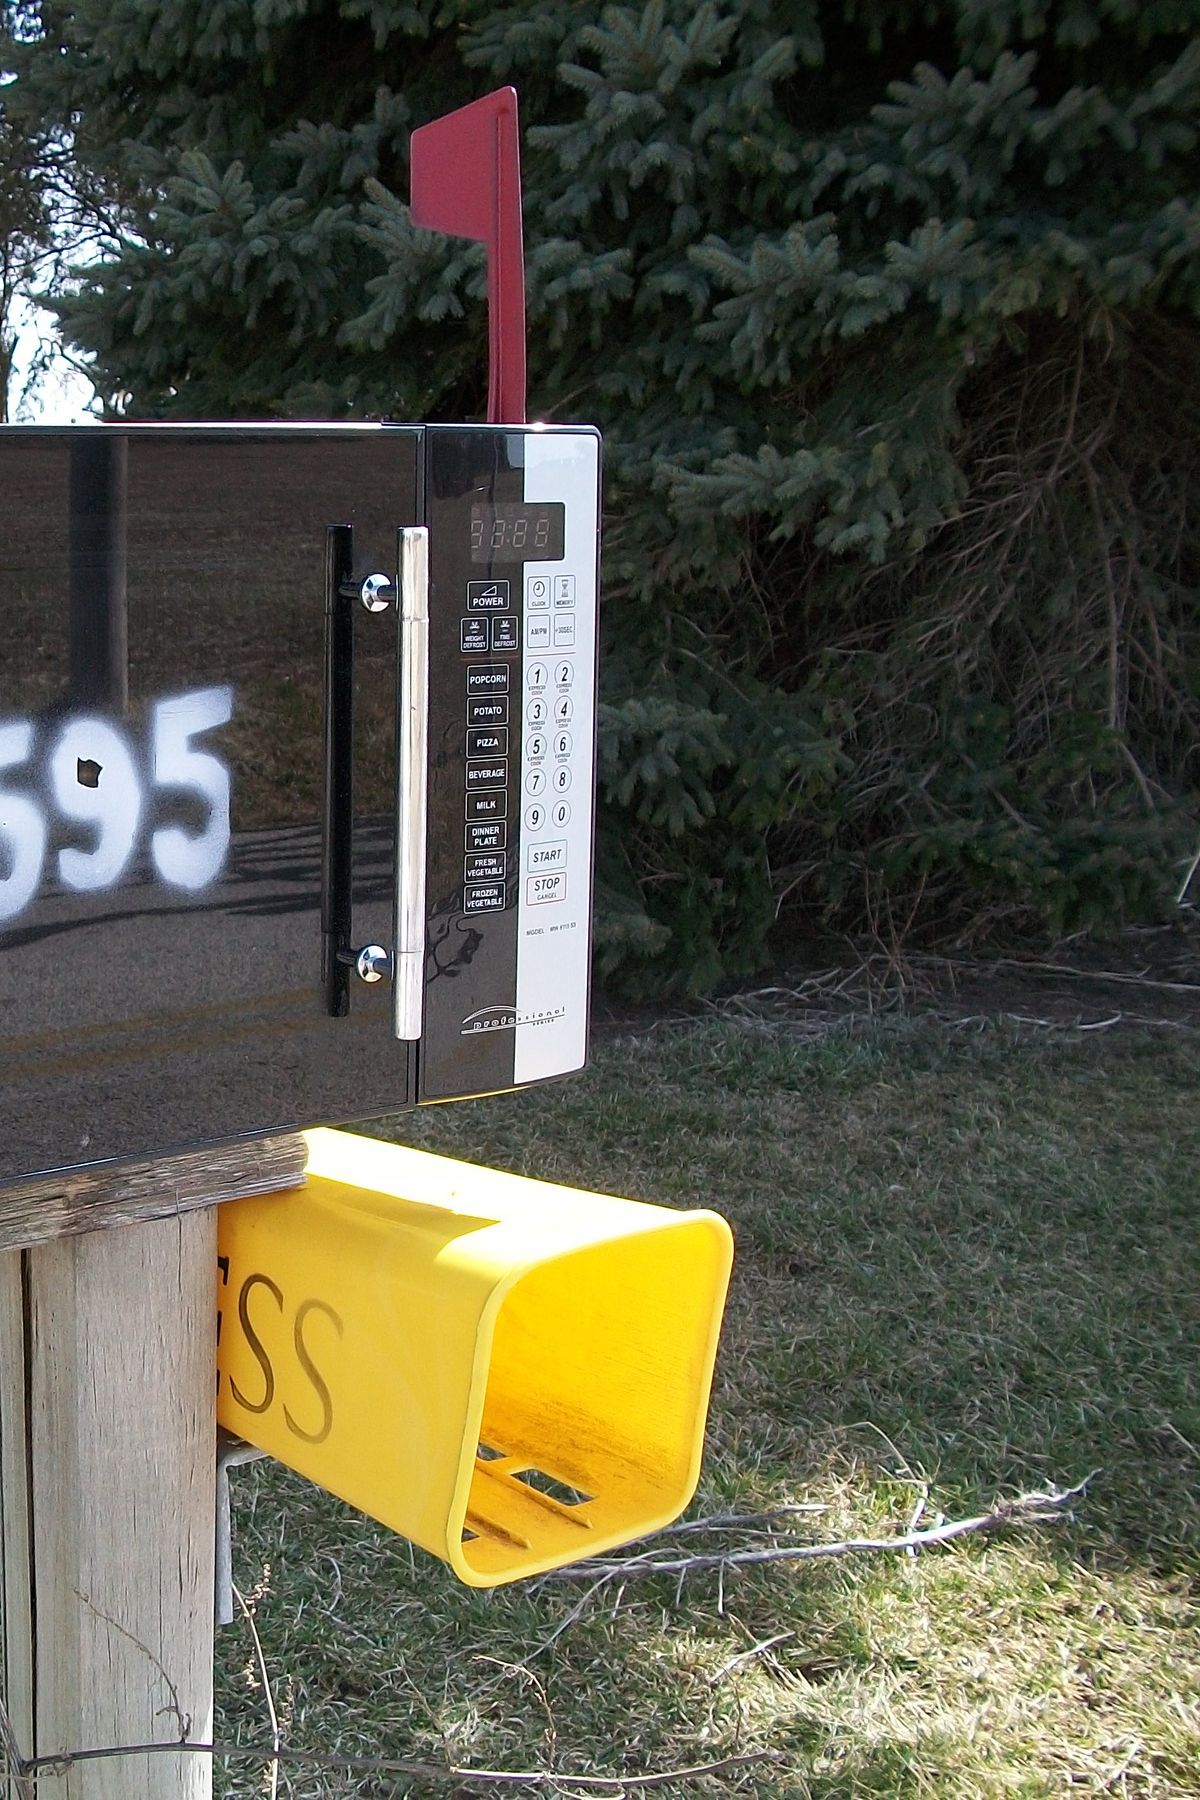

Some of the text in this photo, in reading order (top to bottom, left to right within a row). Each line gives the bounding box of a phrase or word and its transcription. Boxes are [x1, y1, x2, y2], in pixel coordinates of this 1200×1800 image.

[473, 597, 504, 606] POWER
[470, 675, 506, 684] POPCORN
[535, 668, 541, 684] 1
[561, 666, 568, 682] 2
[474, 706, 503, 716] POTATO
[533, 704, 541, 719] 3
[560, 702, 568, 717] 4
[477, 738, 499, 747] PIZZA
[532, 739, 540, 754] 5
[559, 736, 567, 752] 6
[469, 769, 505, 779] BEVERAGE
[559, 772, 566, 786] 8
[533, 775, 540, 790] 7
[476, 801, 496, 809] MILK
[532, 810, 539, 824] 9
[558, 807, 565, 821] 0
[472, 826, 500, 836] DINNER
[474, 837, 497, 846] PLATE
[475, 858, 497, 867] FRESH
[533, 849, 562, 863] START
[467, 867, 503, 877] VEGETABLE
[534, 877, 560, 891] STOP
[472, 889, 499, 898] FROZEN
[467, 898, 503, 908] VEGETABLE
[217, 1256, 344, 1444] SS
